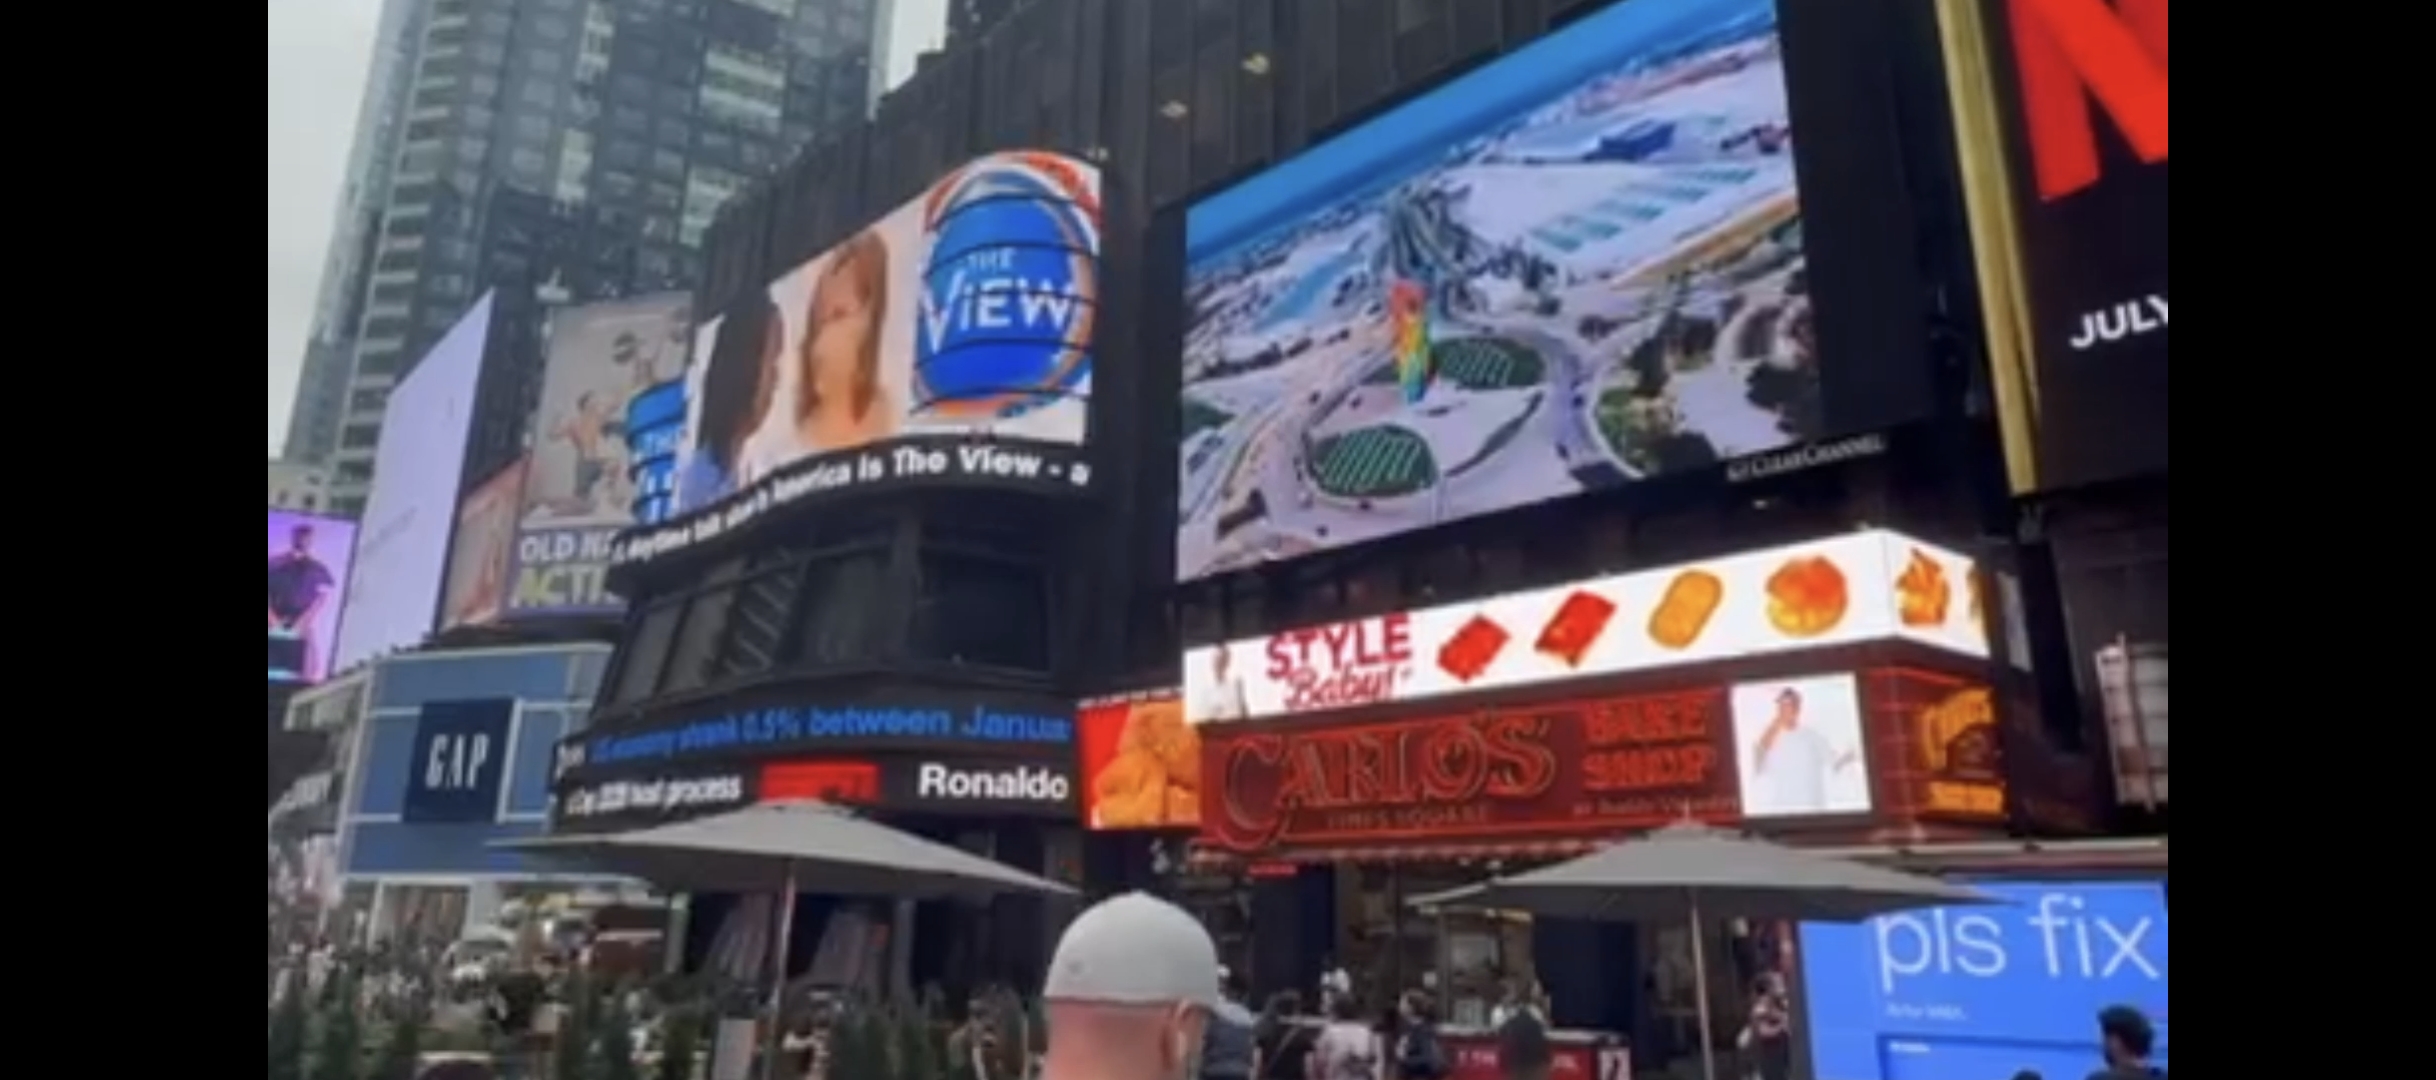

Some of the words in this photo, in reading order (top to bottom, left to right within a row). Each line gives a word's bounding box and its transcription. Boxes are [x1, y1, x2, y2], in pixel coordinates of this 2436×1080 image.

[968, 248, 1017, 272] THE
[858, 454, 884, 484] is
[895, 443, 946, 477] The
[958, 443, 1040, 479] View
[520, 530, 575, 562] OLD
[1266, 612, 1412, 681] STYLE
[809, 706, 950, 738] between
[426, 733, 490, 789] GAP
[1582, 744, 1714, 790] SHOP
[917, 763, 1069, 801] Ronaldo
[1874, 905, 2006, 995] pls
[2028, 892, 2160, 979] fix
